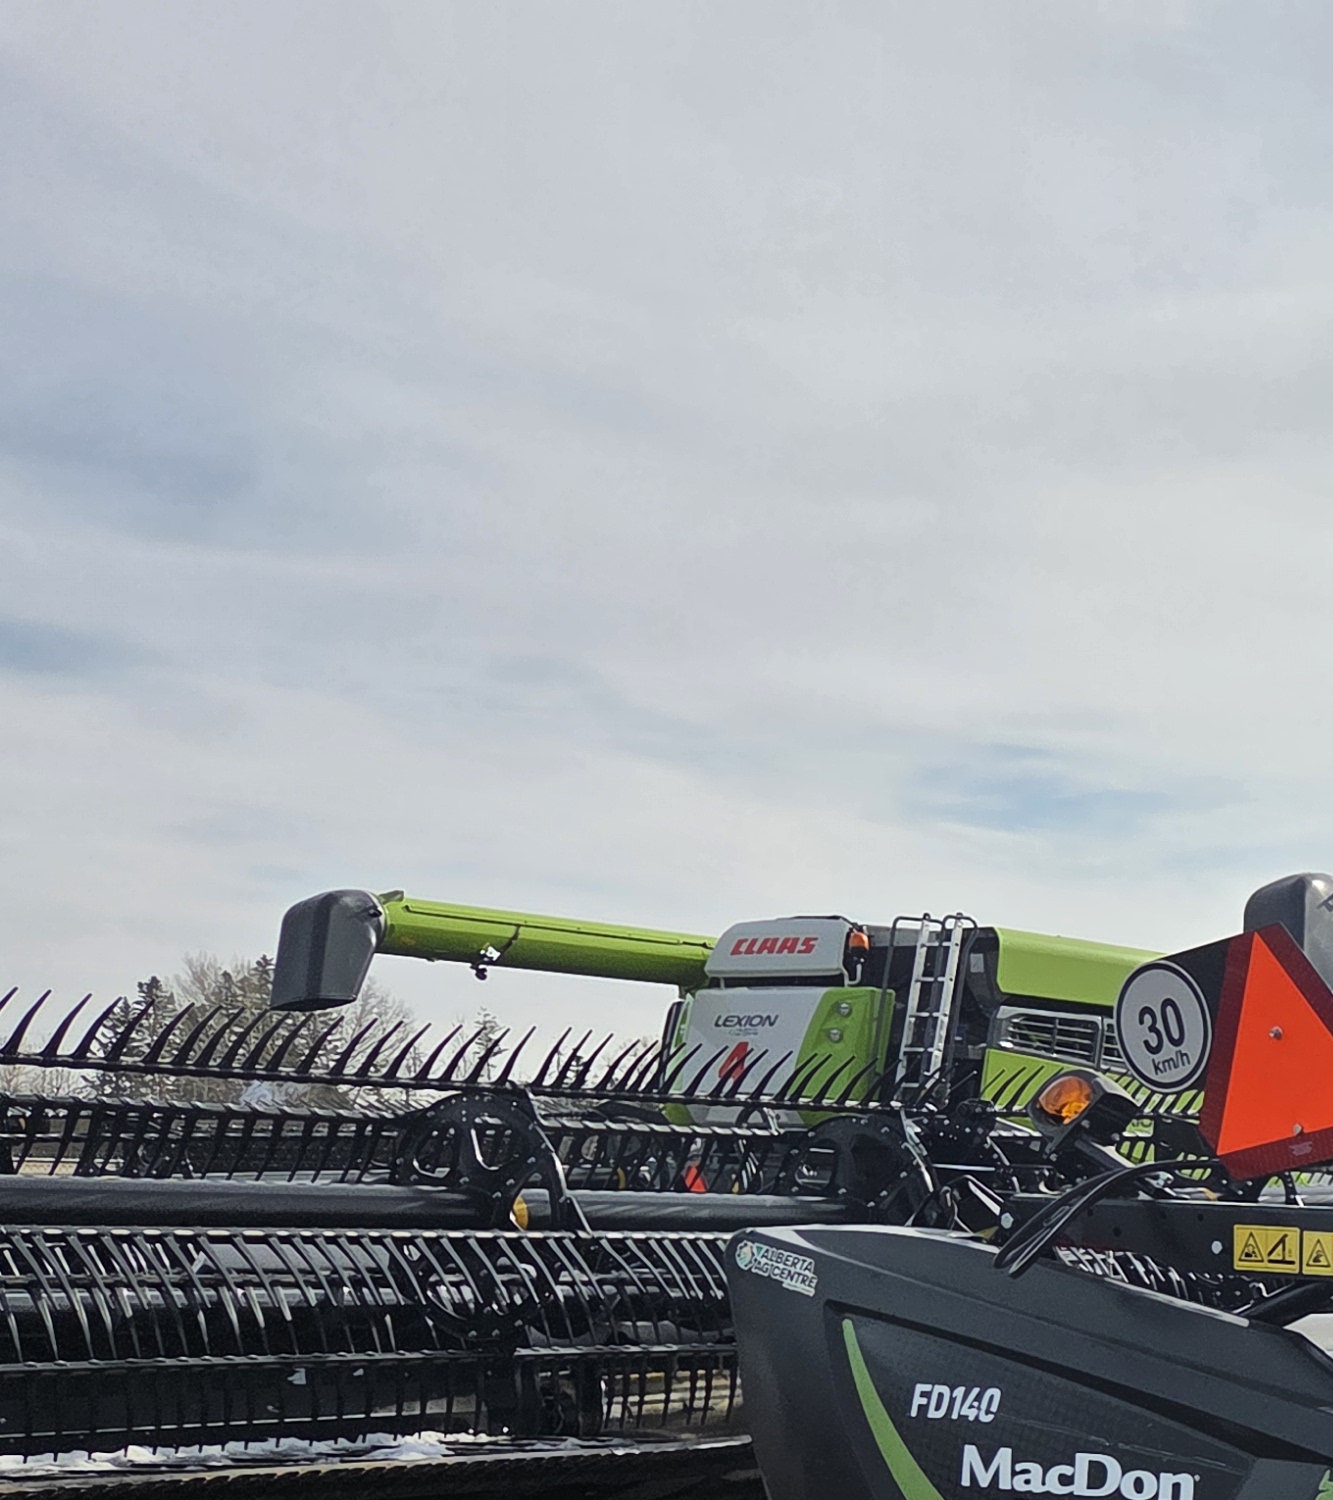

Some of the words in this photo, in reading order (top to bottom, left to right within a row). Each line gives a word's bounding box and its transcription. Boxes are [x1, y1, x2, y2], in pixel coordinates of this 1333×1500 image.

[730, 937, 818, 956] CLAAS
[714, 1014, 779, 1028] LEXION
[1138, 998, 1186, 1055] 30
[1152, 1050, 1191, 1076] km/h
[760, 1247, 815, 1273] ALBERTA
[754, 1259, 771, 1274] AG
[770, 1264, 818, 1289] CENTRE
[910, 1383, 1001, 1423] FD140
